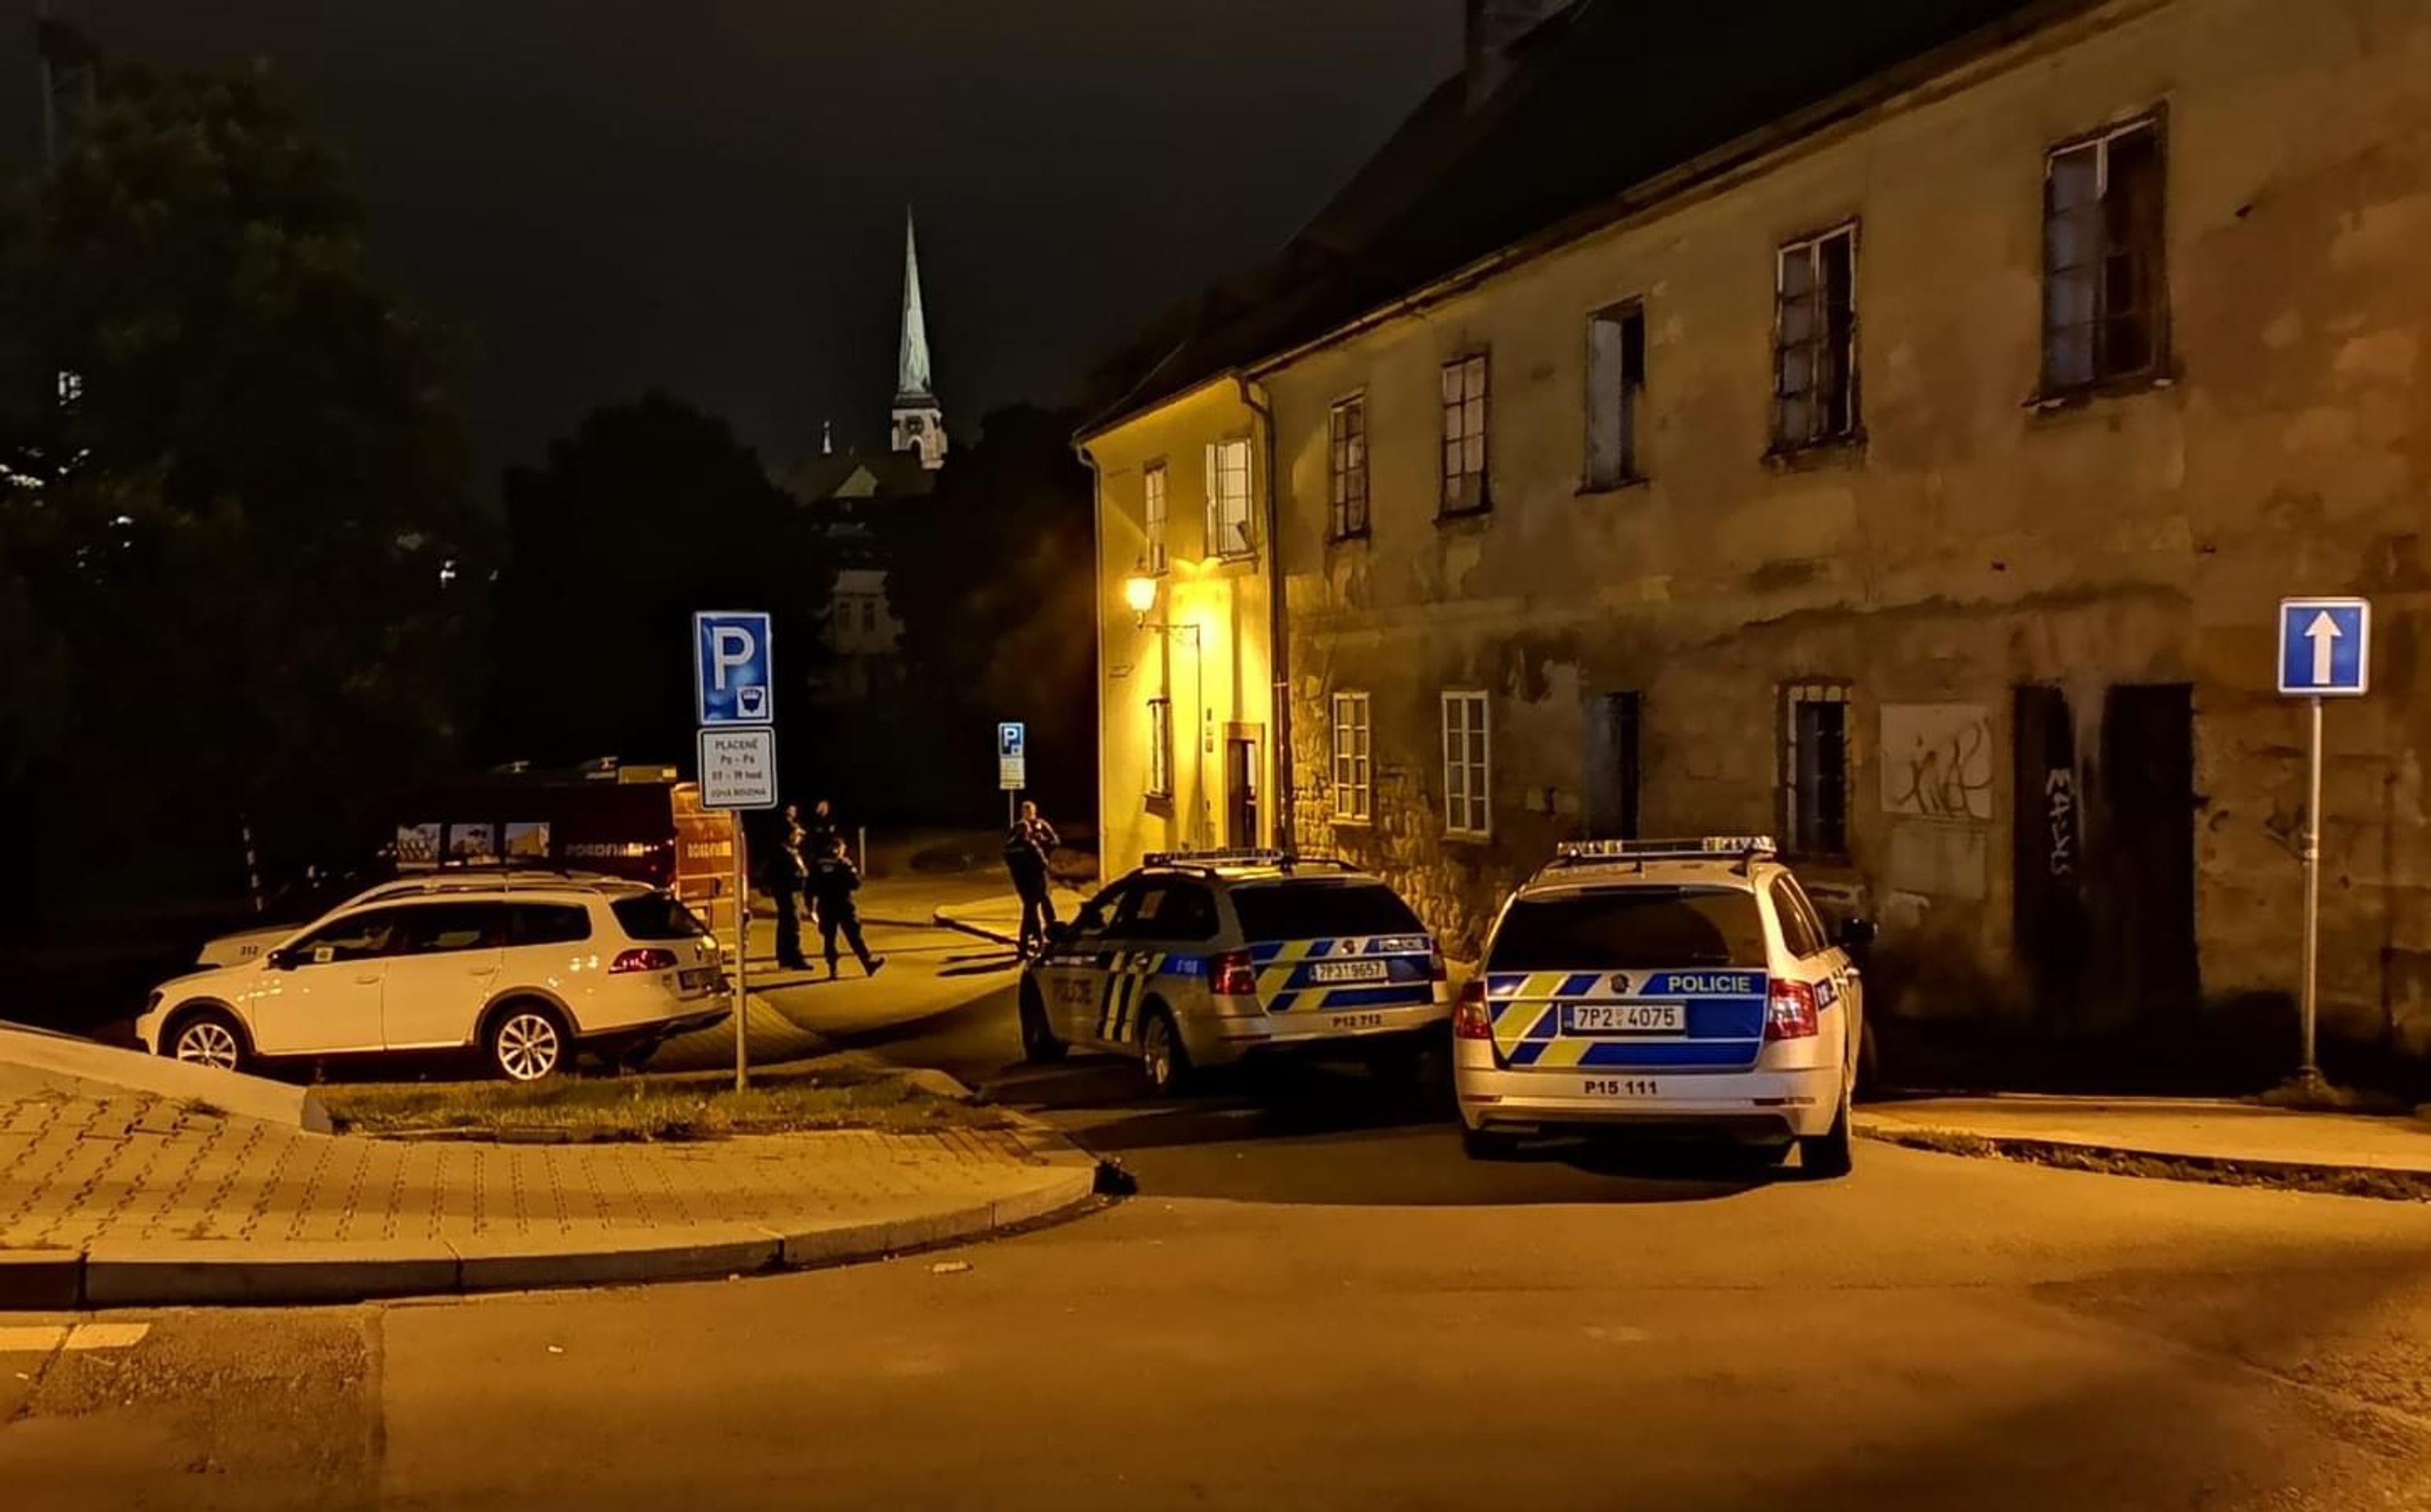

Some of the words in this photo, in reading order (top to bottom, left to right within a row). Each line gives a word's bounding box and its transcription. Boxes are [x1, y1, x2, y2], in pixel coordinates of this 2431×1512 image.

[712, 626, 754, 691] P
[1003, 728, 1018, 747] P
[1669, 976, 1751, 992] POLICIE
[1578, 1008, 1613, 1027] 7P2
[1628, 1008, 1676, 1027] 4075
[1584, 1081, 1618, 1095] P15
[1625, 1081, 1658, 1095] 111
